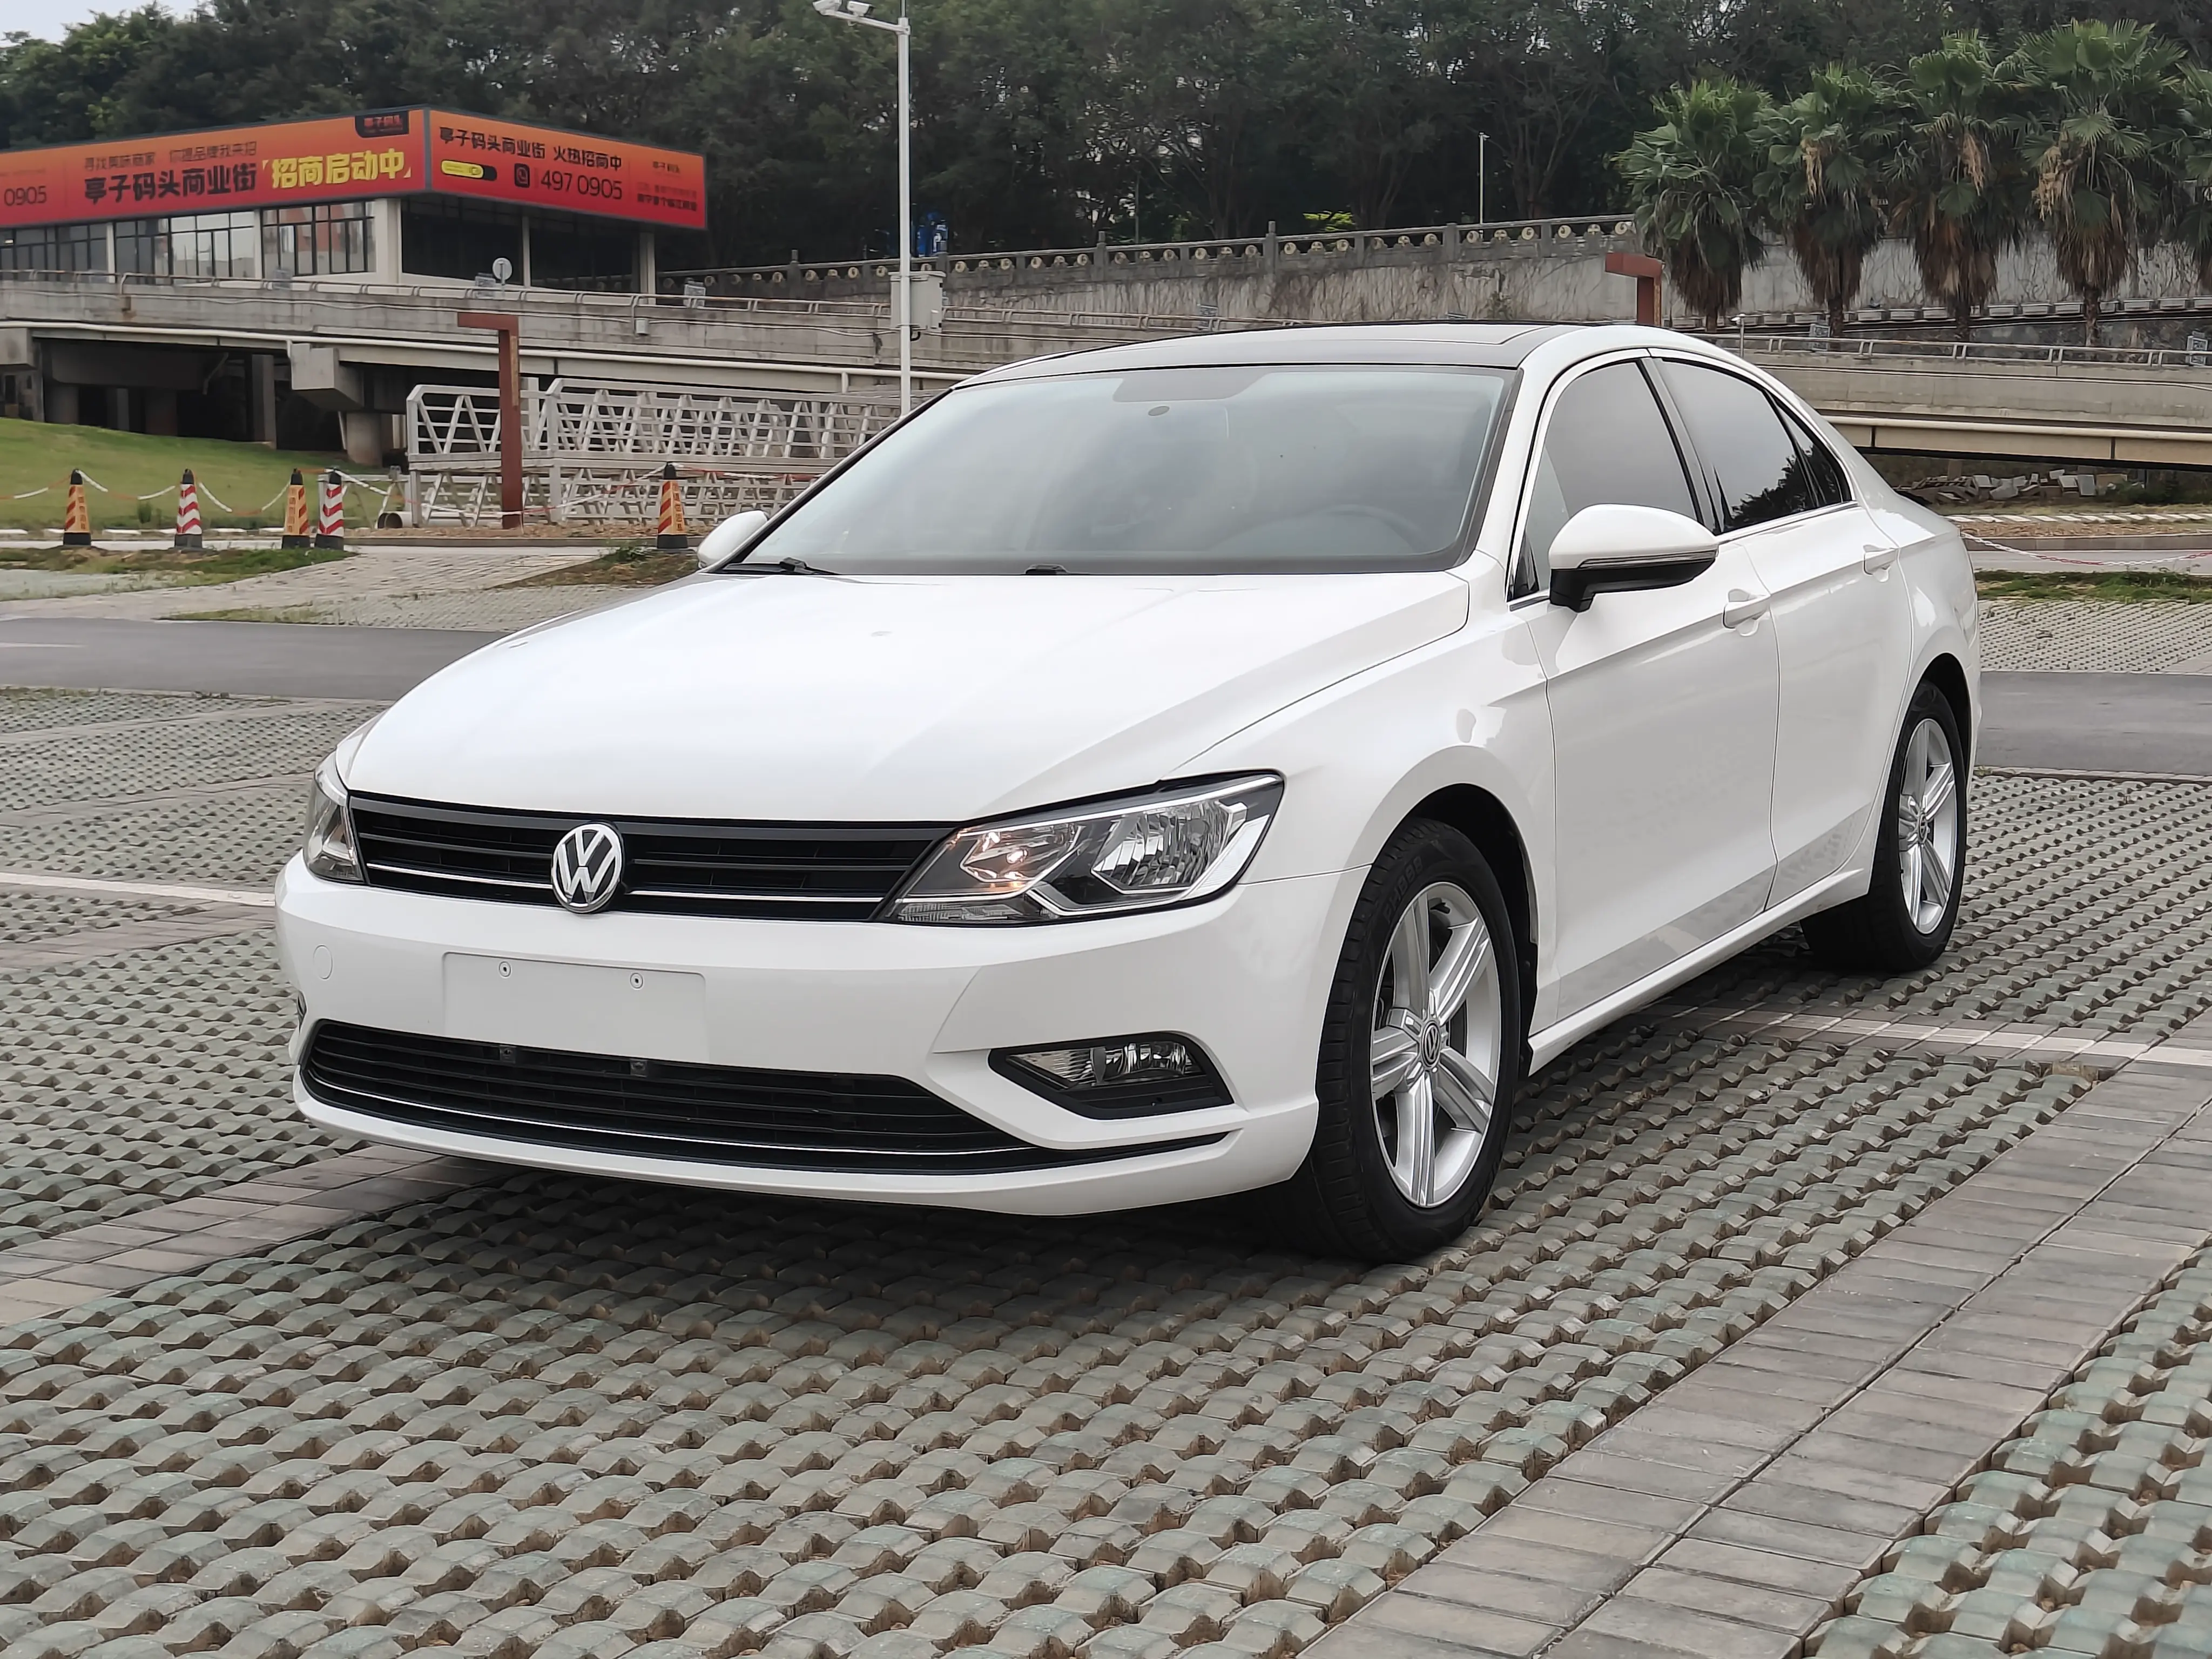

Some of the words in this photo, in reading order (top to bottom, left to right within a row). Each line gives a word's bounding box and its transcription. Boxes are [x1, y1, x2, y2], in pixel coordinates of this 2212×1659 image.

[553, 145, 622, 172] 火热招商中
[84, 163, 257, 205] 亭子码头商业街
[272, 148, 404, 189] 招商启动中
[541, 170, 572, 192] 497
[578, 175, 623, 200] 0905
[4, 186, 47, 206] 0905
[555, 826, 619, 907] VW
